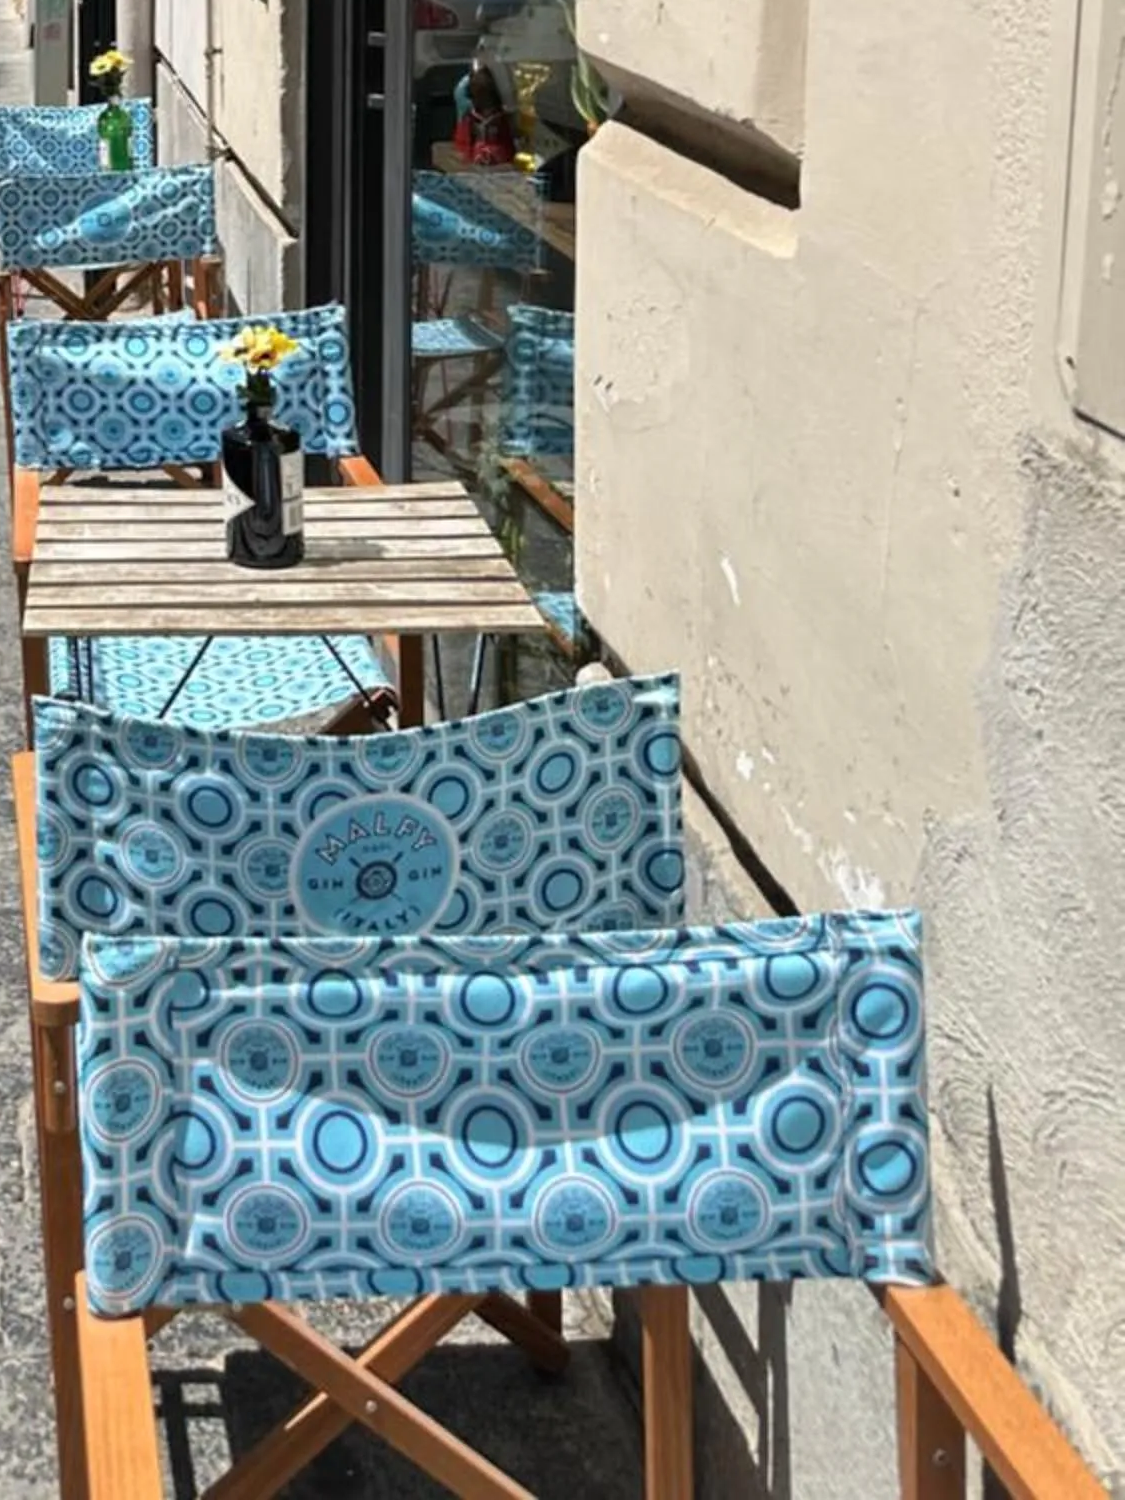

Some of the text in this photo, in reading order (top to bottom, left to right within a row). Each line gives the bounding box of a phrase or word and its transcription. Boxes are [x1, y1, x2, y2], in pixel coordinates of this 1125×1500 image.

[315, 811, 437, 866] MALFY
[408, 865, 442, 881] GIN
[308, 877, 343, 890] GIN
